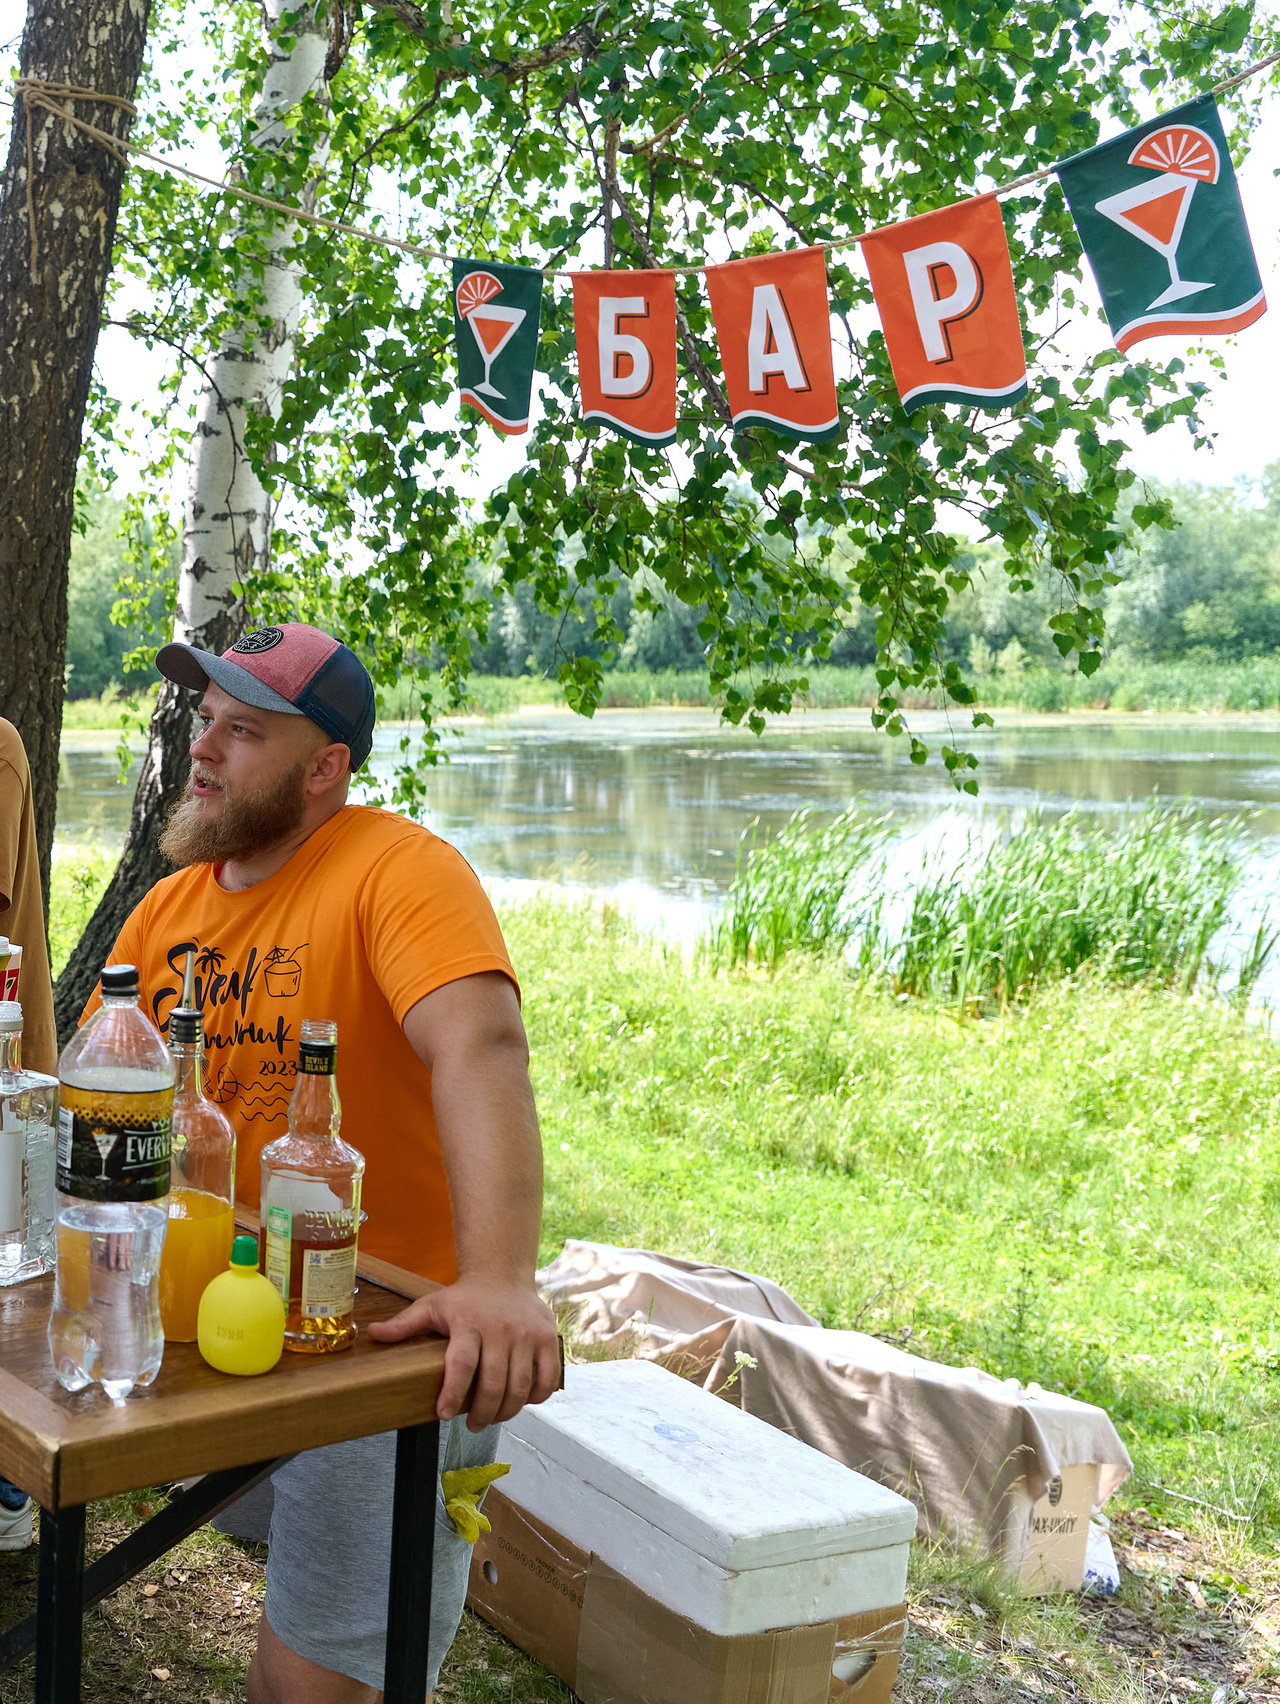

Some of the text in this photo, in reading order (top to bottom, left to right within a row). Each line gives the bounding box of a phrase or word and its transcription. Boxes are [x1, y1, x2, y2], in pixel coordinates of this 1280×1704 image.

[598, 241, 985, 399] БАР
[259, 1060, 298, 1076] 2023
[305, 1064, 328, 1072] ISLAND
